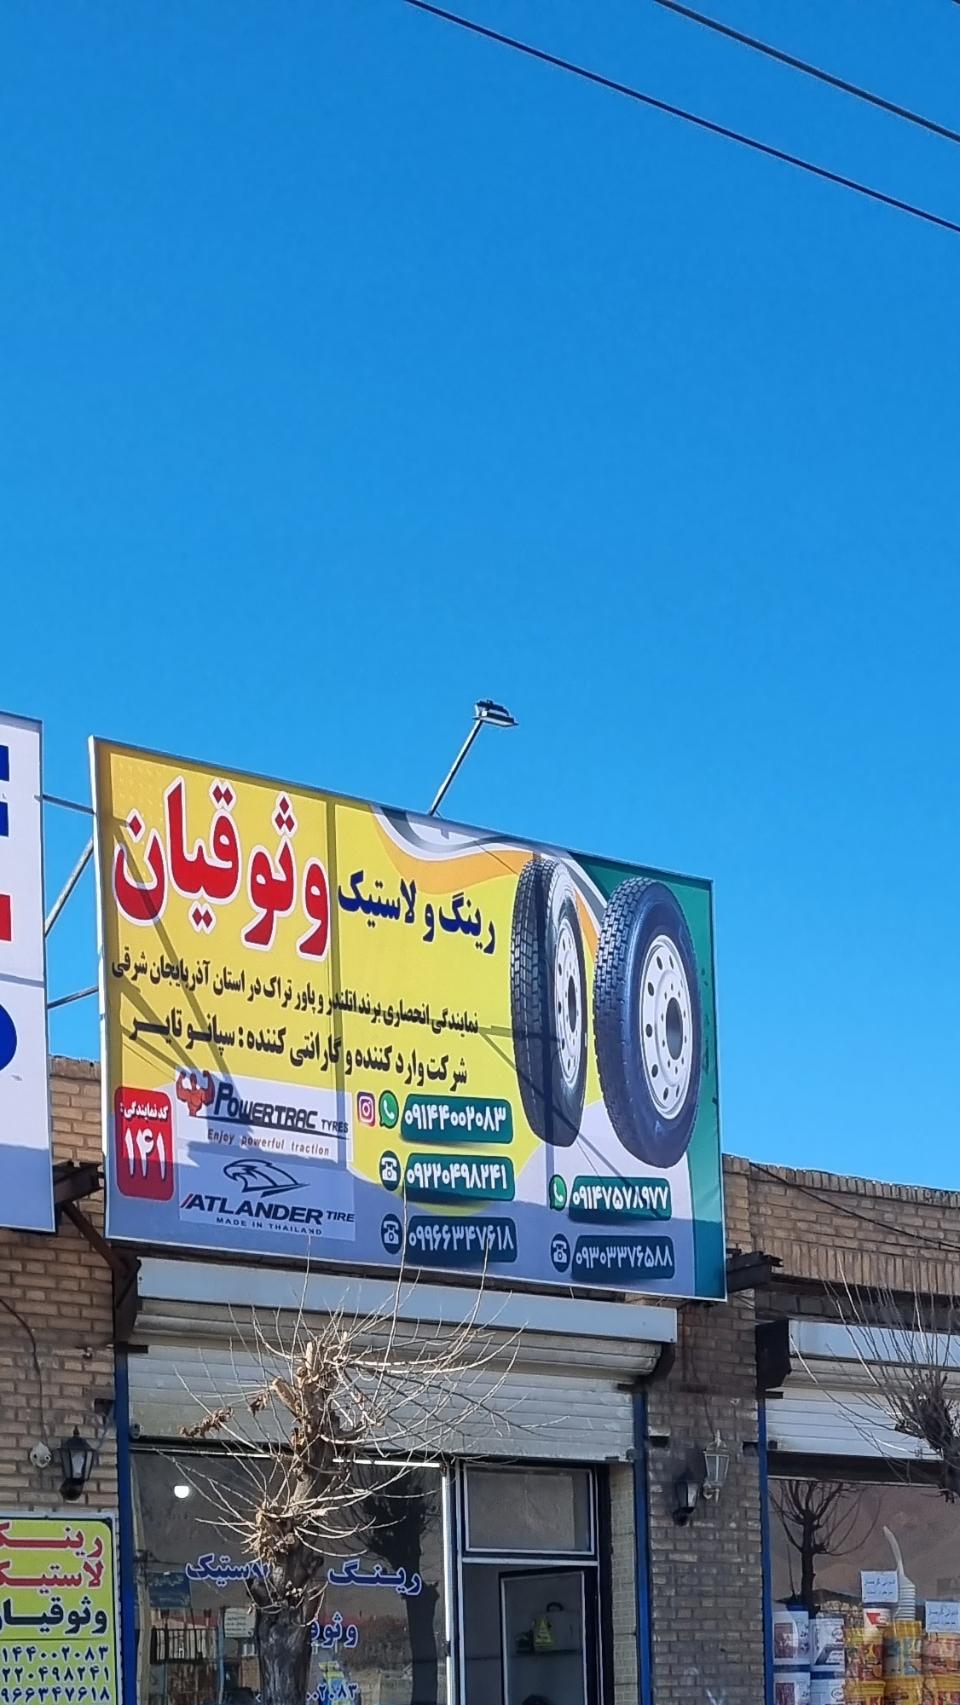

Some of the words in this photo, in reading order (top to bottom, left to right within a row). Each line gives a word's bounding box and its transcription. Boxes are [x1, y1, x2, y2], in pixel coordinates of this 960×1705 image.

[113, 779, 331, 959] وثوقیان
[337, 869, 417, 929] لاستیک
[422, 903, 435, 943] و
[438, 892, 495, 955] رینگ
[112, 946, 148, 982] شرقی
[149, 954, 211, 991] آذربایجان
[213, 966, 245, 995] استان
[247, 977, 262, 1001] در
[263, 976, 292, 1008] تراک
[294, 982, 316, 1014] پاور
[317, 994, 324, 1014] و
[326, 989, 357, 1016] اتلندر
[359, 993, 381, 1023] برند
[382, 999, 430, 1027] انحصاری
[128, 1007, 182, 1045] تایر
[185, 1013, 235, 1057] سپانو
[431, 1007, 478, 1037] نمایندگی
[290, 1031, 342, 1071] گارانتی
[344, 1049, 353, 1075] و
[355, 1044, 392, 1072] کننده
[394, 1049, 425, 1086] وارد
[426, 1054, 467, 1092] شرکت
[157, 1105, 169, 1120] کد
[213, 1081, 318, 1129] POWERTRAC
[320, 1118, 349, 1134] TYRES
[404, 1103, 507, 1131] ۰۹۱۴۴۰۰۲۰۸۳
[124, 1127, 166, 1181] ۱۴۱
[207, 1128, 235, 1145] Enjoy
[240, 1135, 285, 1150] powerful
[291, 1141, 330, 1156] traction
[406, 1162, 507, 1189] ۰۹۲۲۰۴۹۸۲۴۱
[181, 1192, 324, 1226] ATLANDER
[326, 1210, 355, 1223] TIRE
[572, 1185, 669, 1210] ۰۹۱۴۷۵۷۸۹۷۷
[216, 1216, 248, 1227] MADE
[269, 1223, 323, 1236] THAILAND
[408, 1224, 514, 1251] ۰۹۹۶۶۳۴۷۶۱۸
[575, 1245, 673, 1269] ۰۹۳۰۳۳۷۶۵۸۸
[327, 1558, 423, 1596] رینگ
[0, 1596, 107, 1634] وثوقیا
